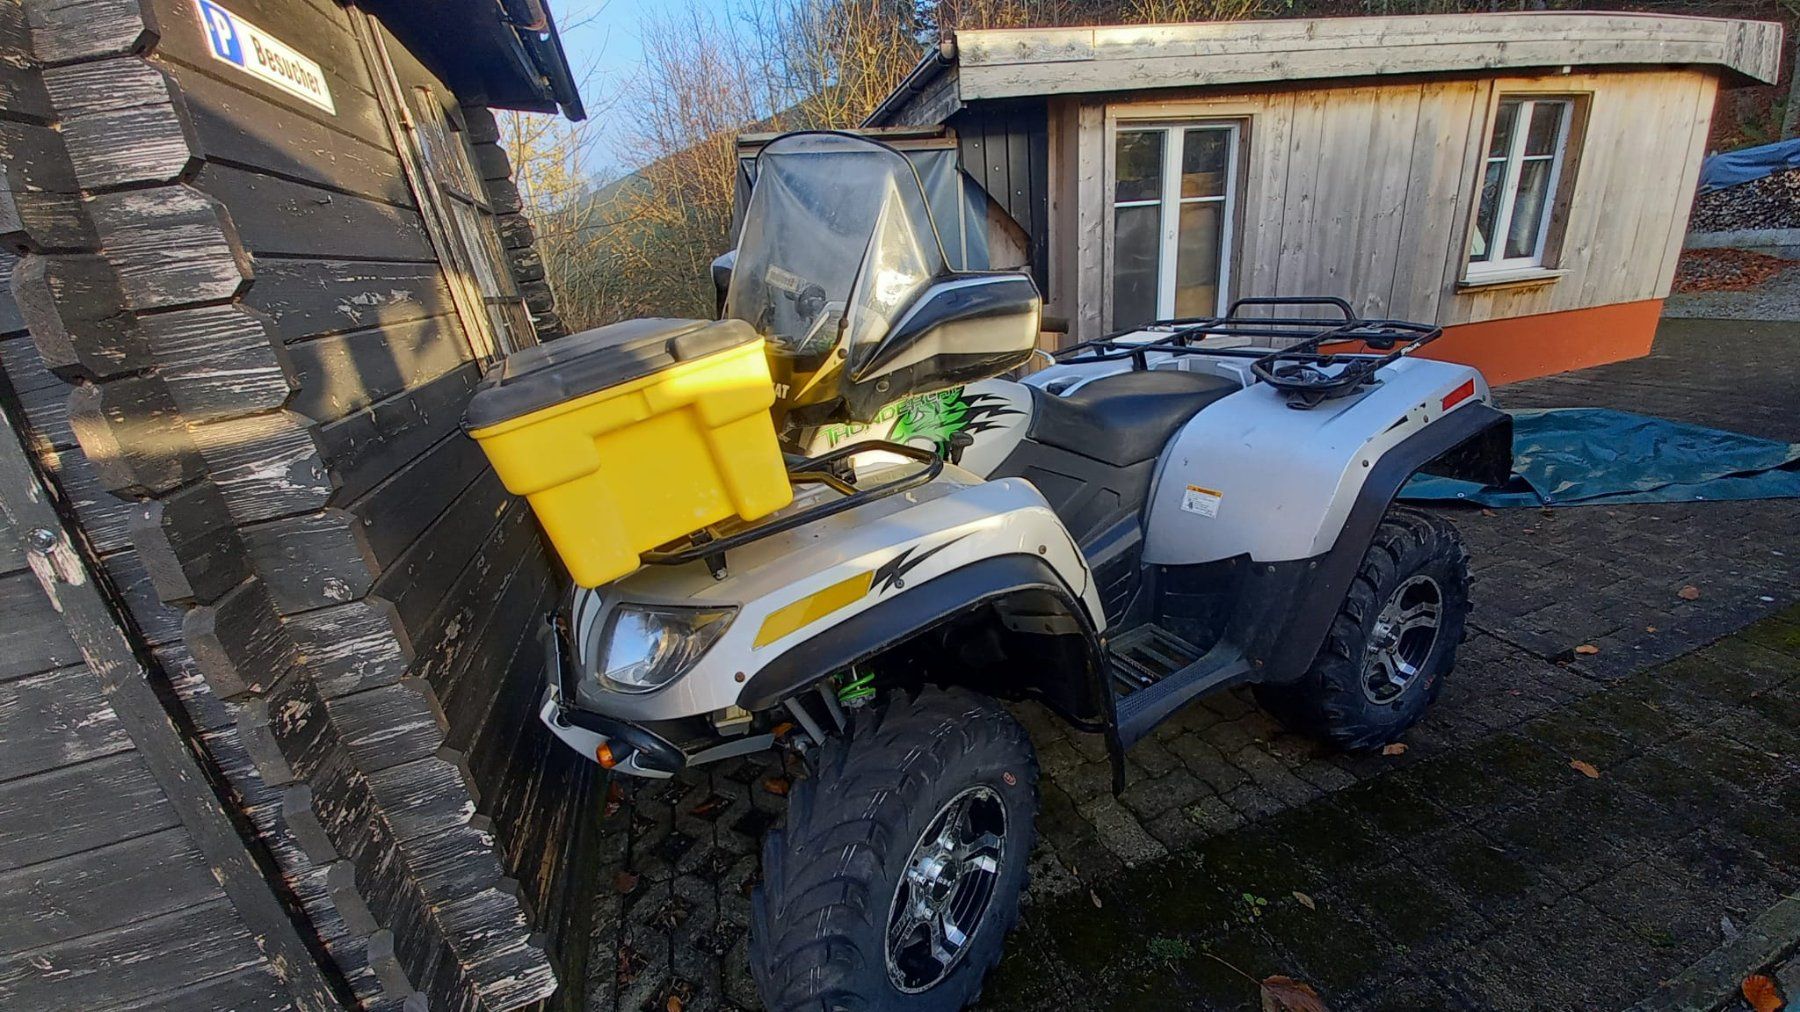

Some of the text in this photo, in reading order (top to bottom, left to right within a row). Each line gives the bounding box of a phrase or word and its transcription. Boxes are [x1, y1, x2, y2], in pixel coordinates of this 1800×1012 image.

[208, 7, 321, 96] P Besucher
[774, 382, 790, 399] AT
